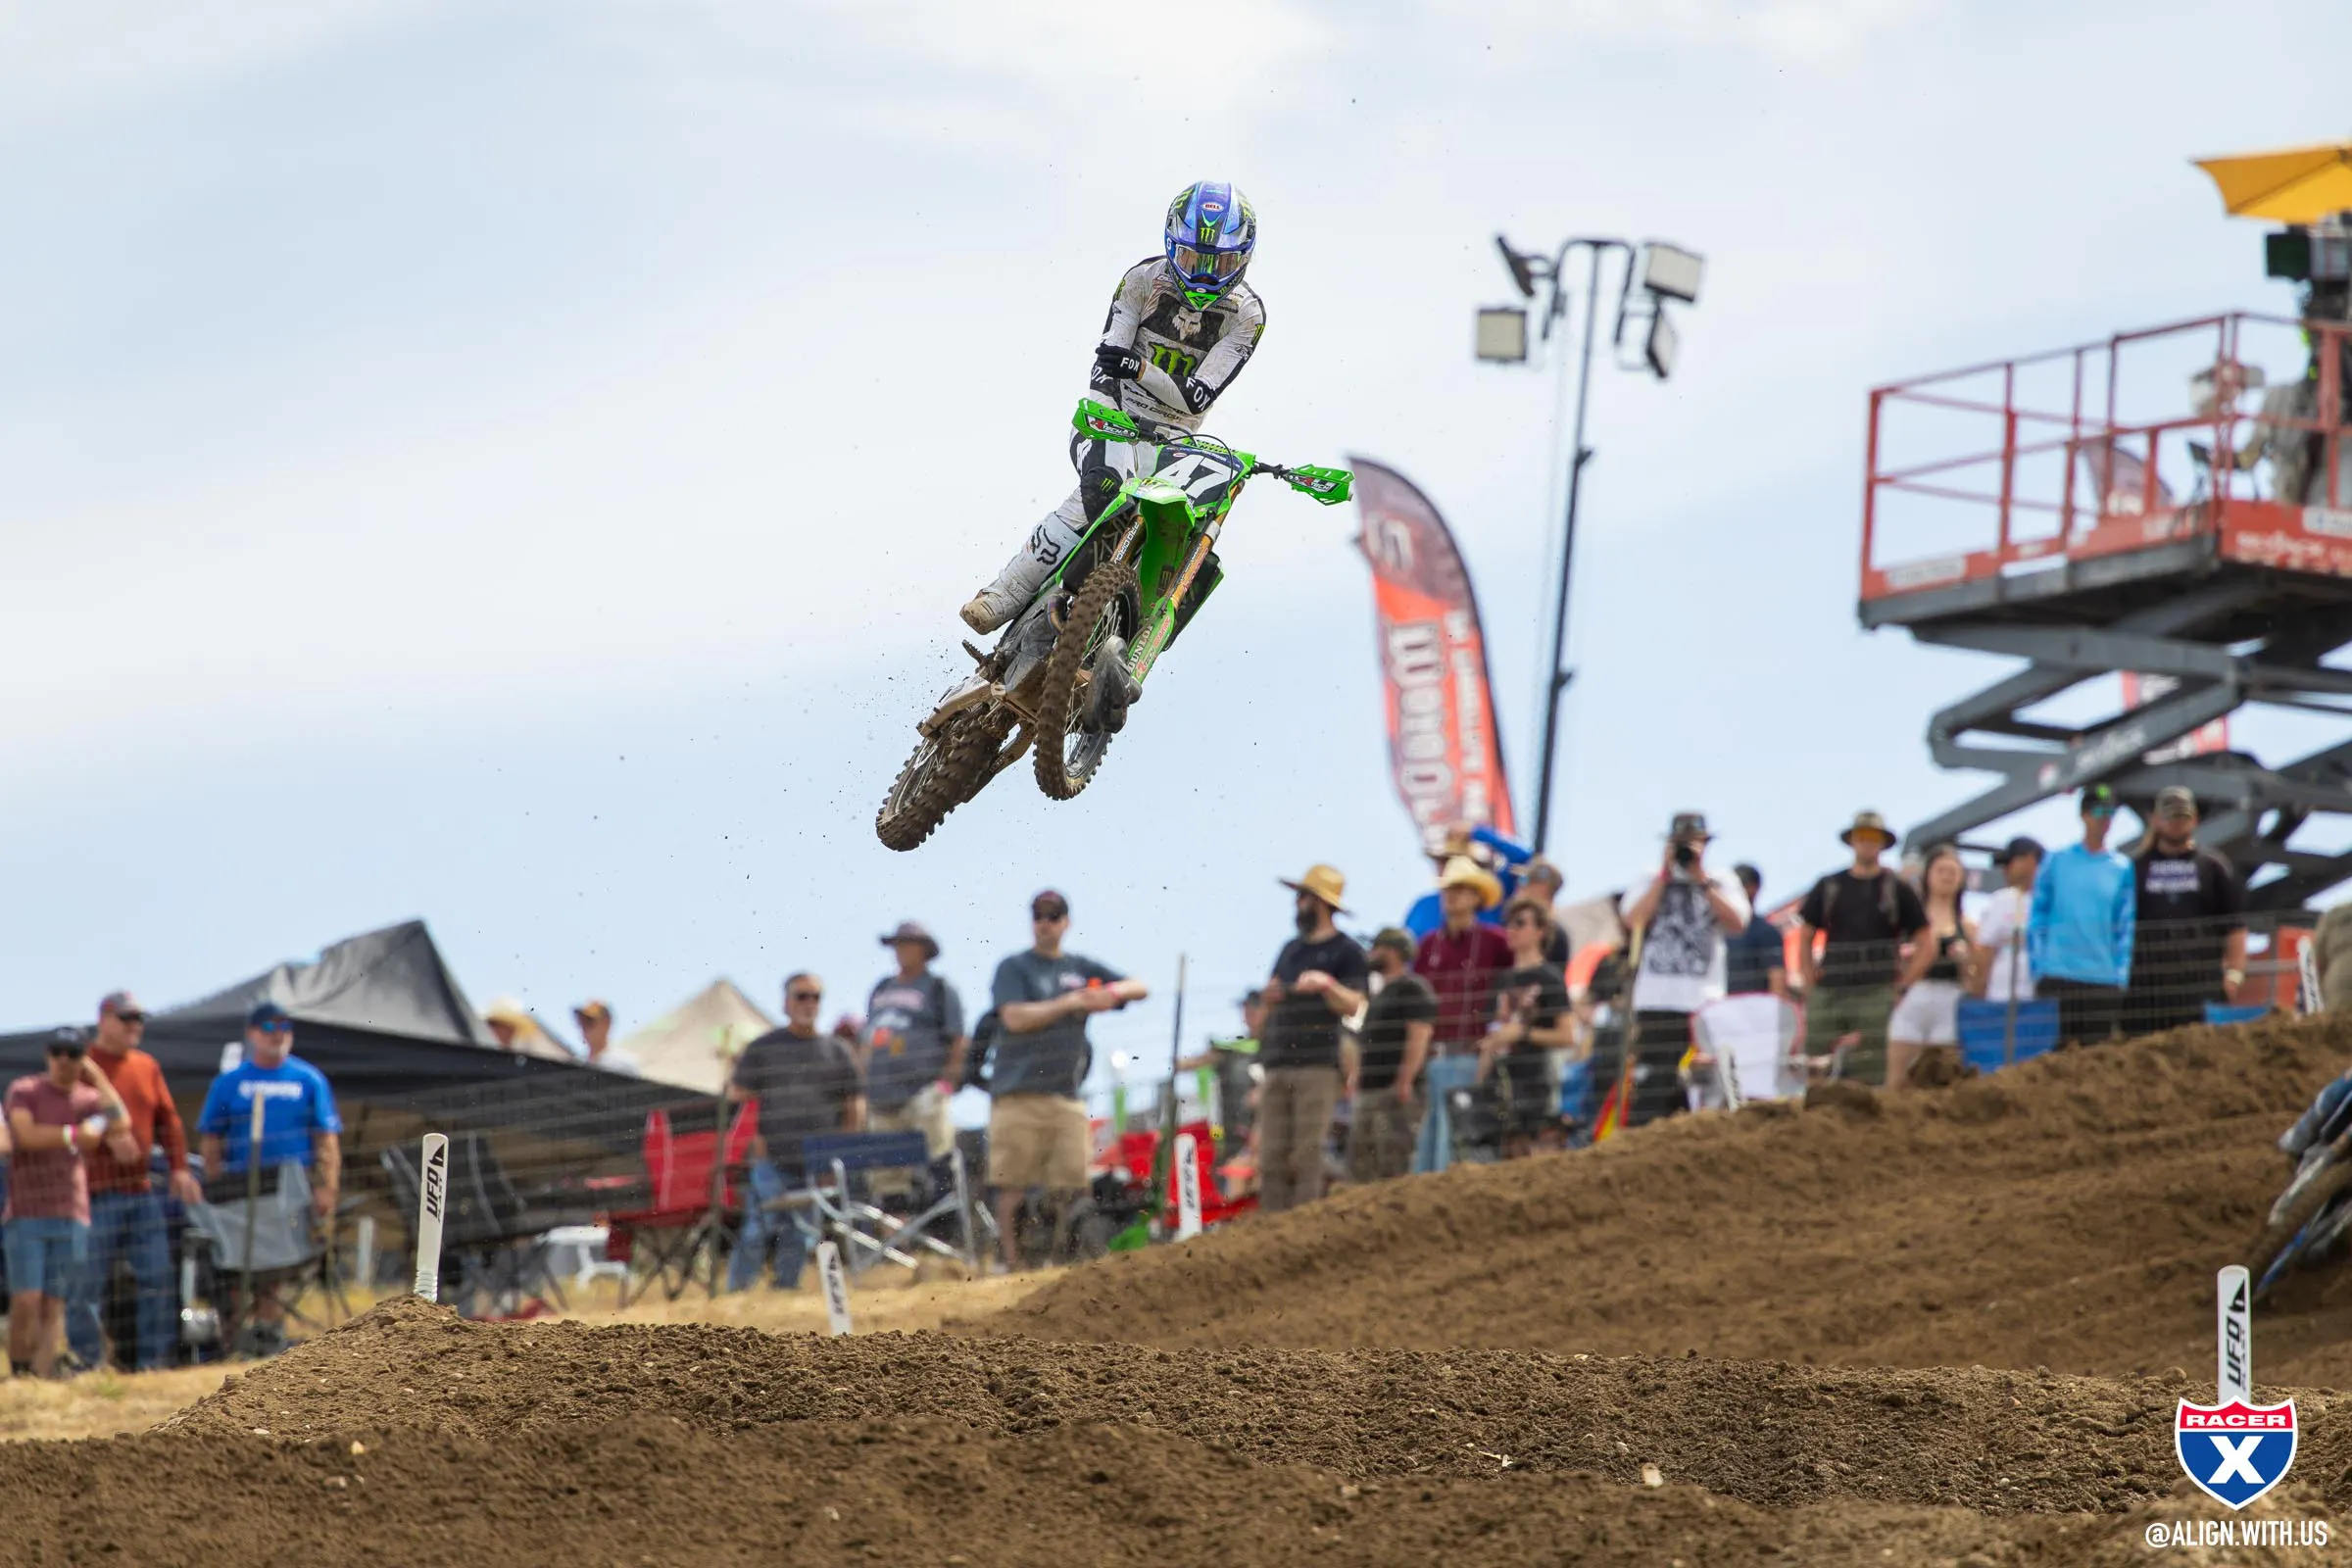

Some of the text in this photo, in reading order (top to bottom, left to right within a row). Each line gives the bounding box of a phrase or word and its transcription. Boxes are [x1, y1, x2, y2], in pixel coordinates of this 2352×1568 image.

[1091, 365, 1114, 384] OX
[1120, 357, 1141, 372] FOX
[1186, 376, 1211, 411] FOX
[1152, 454, 1239, 499] 47
[426, 1166, 439, 1219] UFO
[2227, 1315, 2241, 1388] UFO
